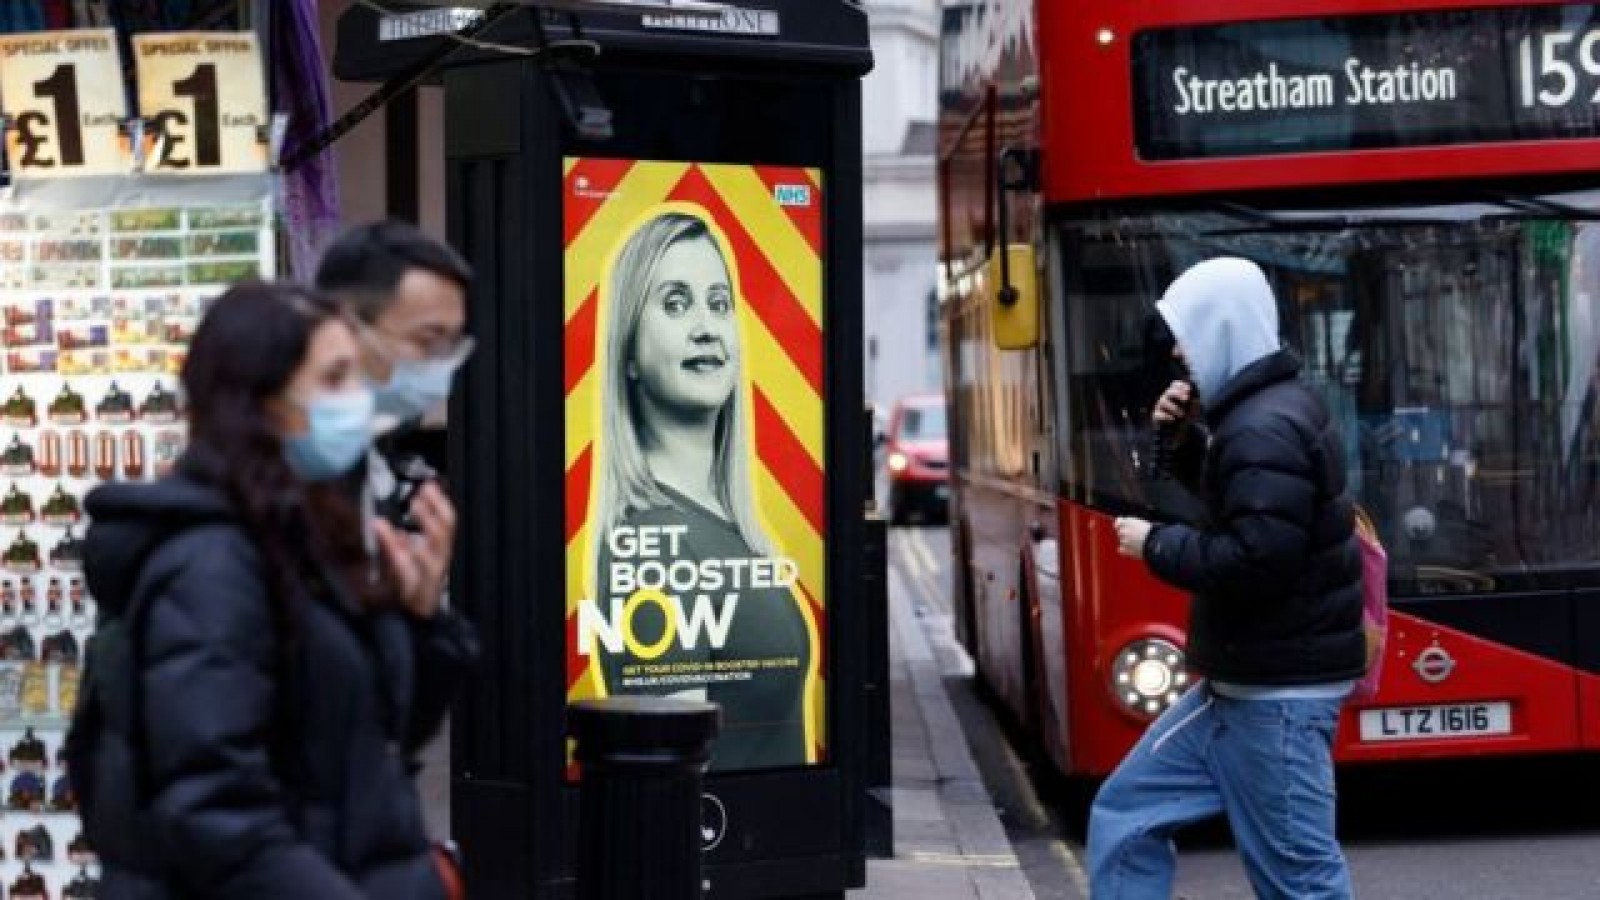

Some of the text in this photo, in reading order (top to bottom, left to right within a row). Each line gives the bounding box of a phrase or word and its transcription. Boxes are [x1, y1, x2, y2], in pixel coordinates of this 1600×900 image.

[1173, 58, 1456, 114] Streatham Station
[1519, 29, 1600, 108] 159
[14, 62, 85, 168] £1
[157, 62, 222, 168] £1
[776, 187, 808, 204] NHS
[609, 524, 689, 558] GET
[609, 558, 800, 593] BOOSTED
[576, 588, 739, 660] NOW
[1381, 706, 1489, 736] LTZ 1616
